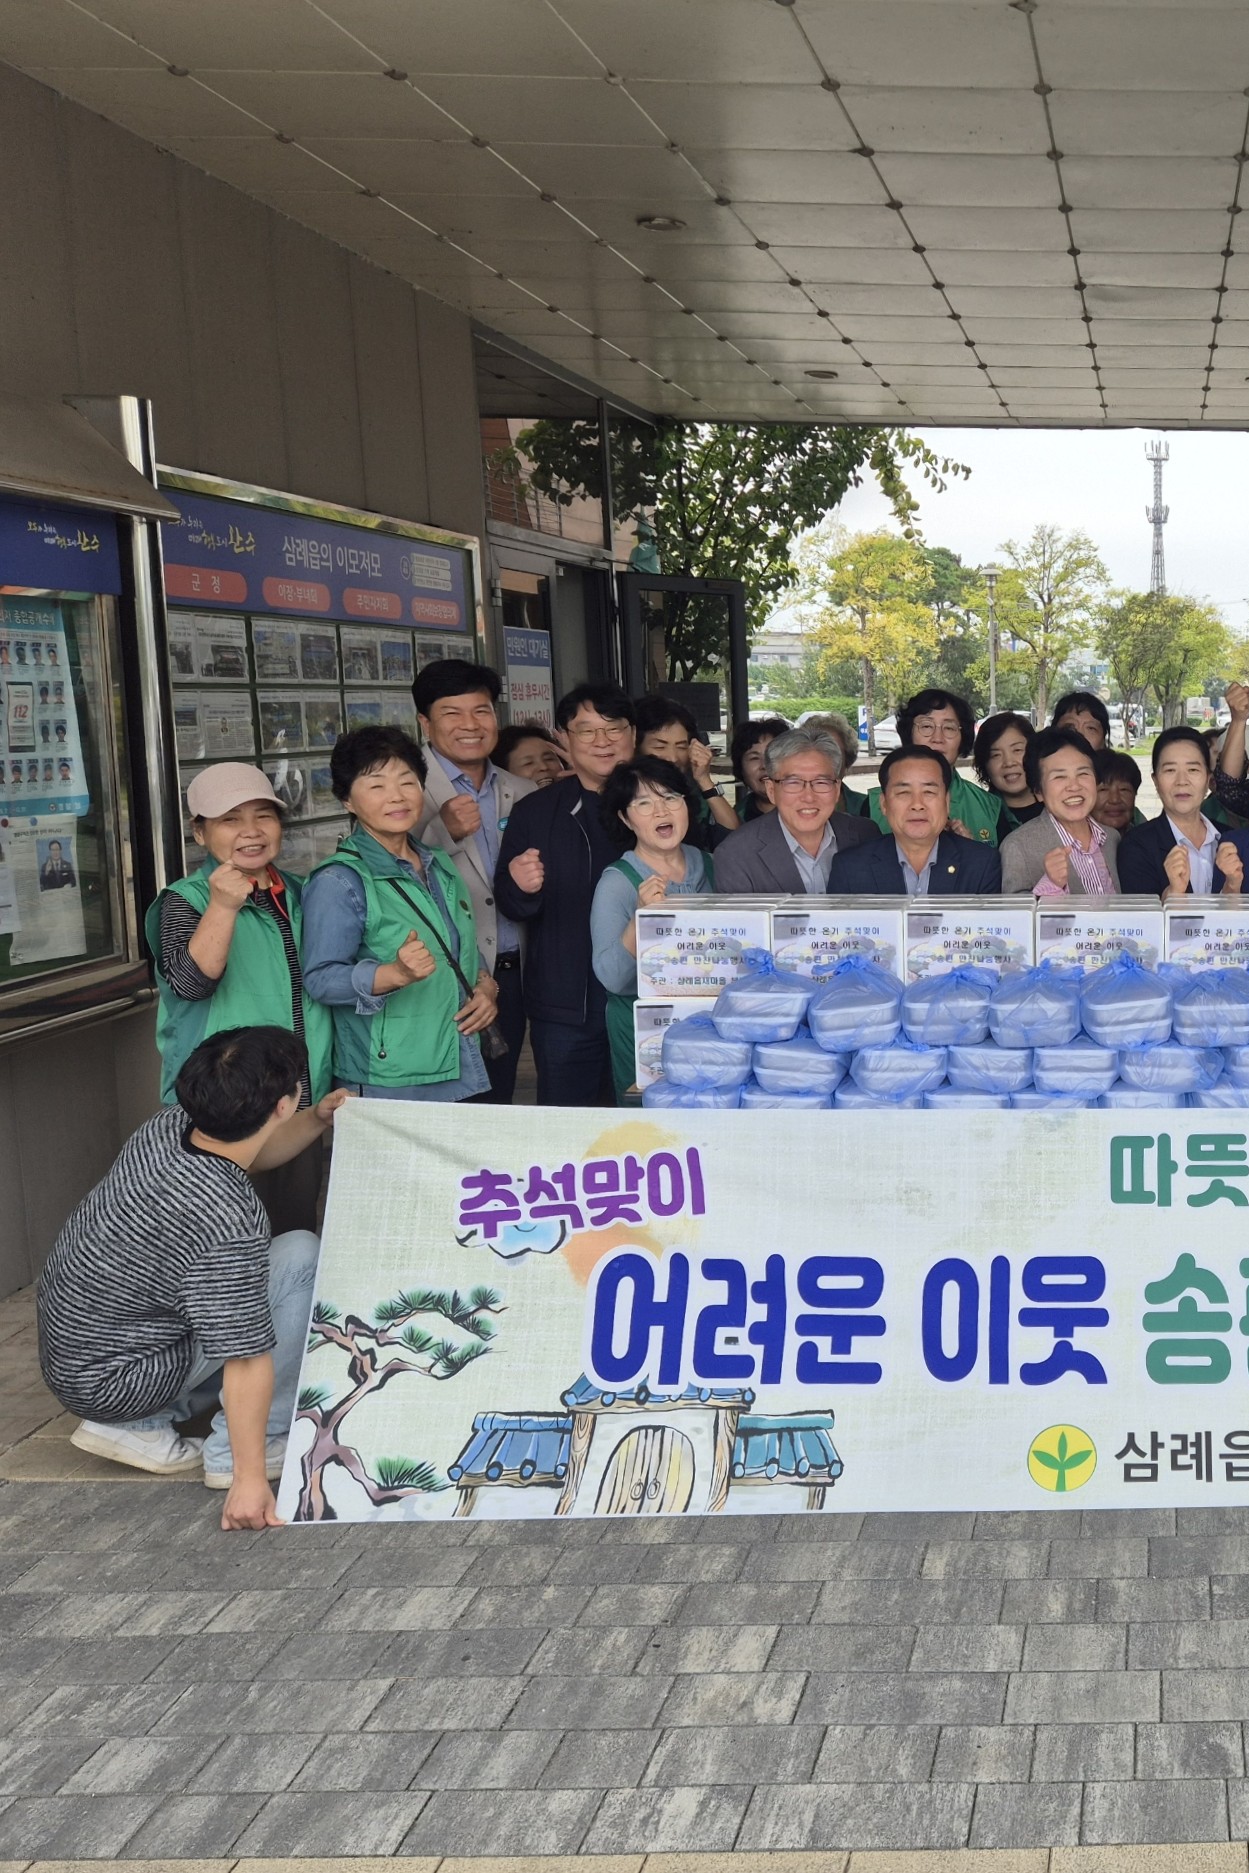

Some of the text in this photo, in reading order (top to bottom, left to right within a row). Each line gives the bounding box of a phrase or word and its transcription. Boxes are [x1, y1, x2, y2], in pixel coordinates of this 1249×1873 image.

[282, 535, 333, 573] 삼례읍의
[336, 545, 383, 578] 이모저모
[506, 636, 549, 659] 민원인 대기실
[511, 682, 550, 701] 점심 휴무시간
[14, 704, 29, 718] 112
[656, 928, 682, 936] 따뜻한
[689, 928, 705, 936] 온기
[791, 927, 816, 935] 따뜻한
[822, 927, 838, 935] 온기
[1056, 928, 1081, 936] 따뜻한
[1087, 928, 1103, 936] 온기
[1185, 929, 1210, 937] 따뜻한
[1216, 929, 1232, 937] 온기
[709, 942, 726, 950] 이웃
[1107, 942, 1123, 950] 이웃
[459, 1147, 706, 1238] 추석맞이
[591, 1252, 887, 1386] 어려운
[922, 1255, 1111, 1386] 이웃
